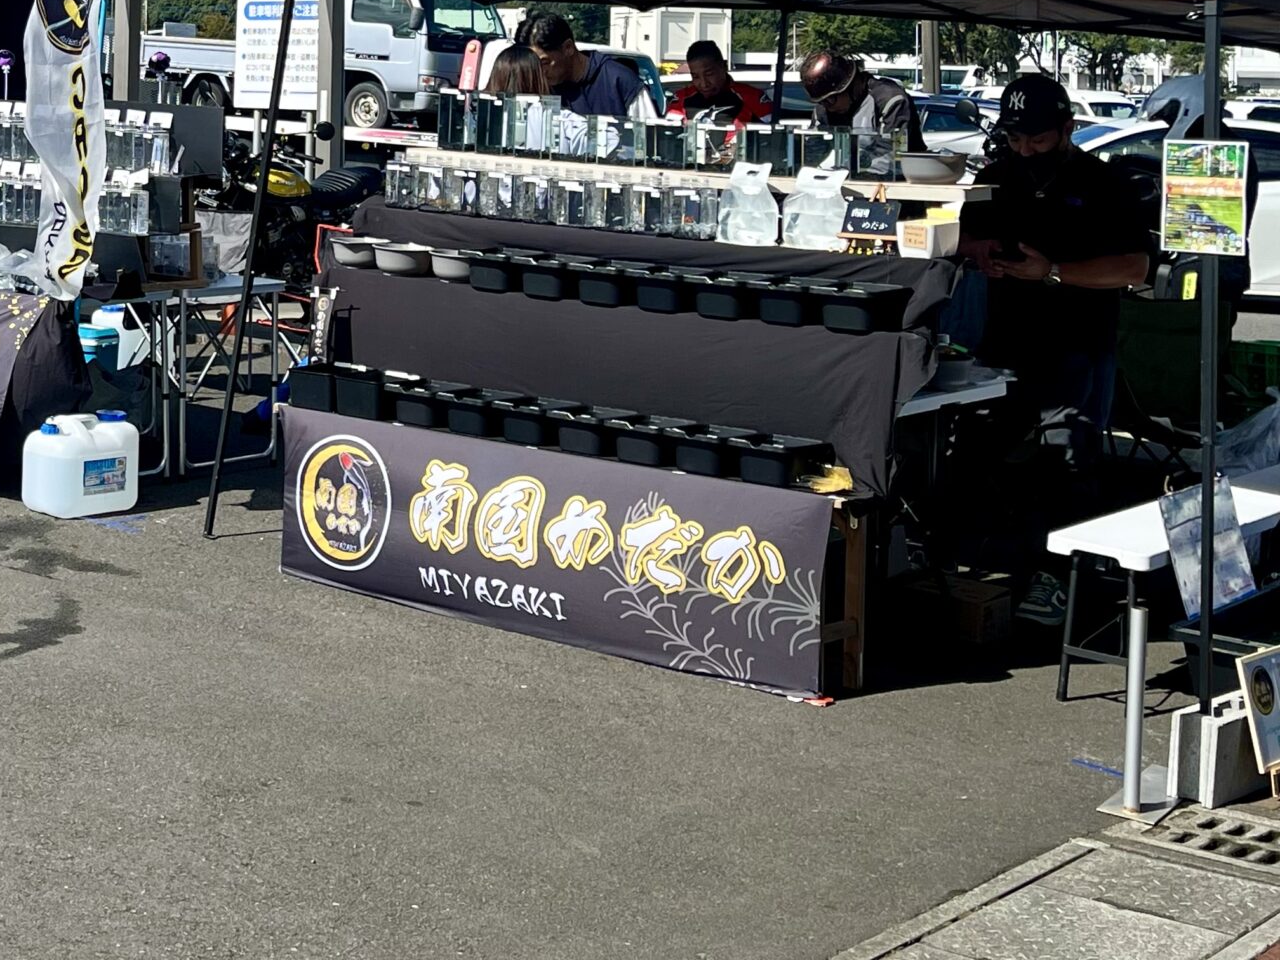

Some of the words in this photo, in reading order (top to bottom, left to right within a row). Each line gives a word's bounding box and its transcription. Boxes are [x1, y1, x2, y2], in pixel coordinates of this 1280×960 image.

[861, 221, 888, 230] めだか
[409, 459, 786, 604] 南国めだか
[418, 566, 568, 621] MIYAZAKI
